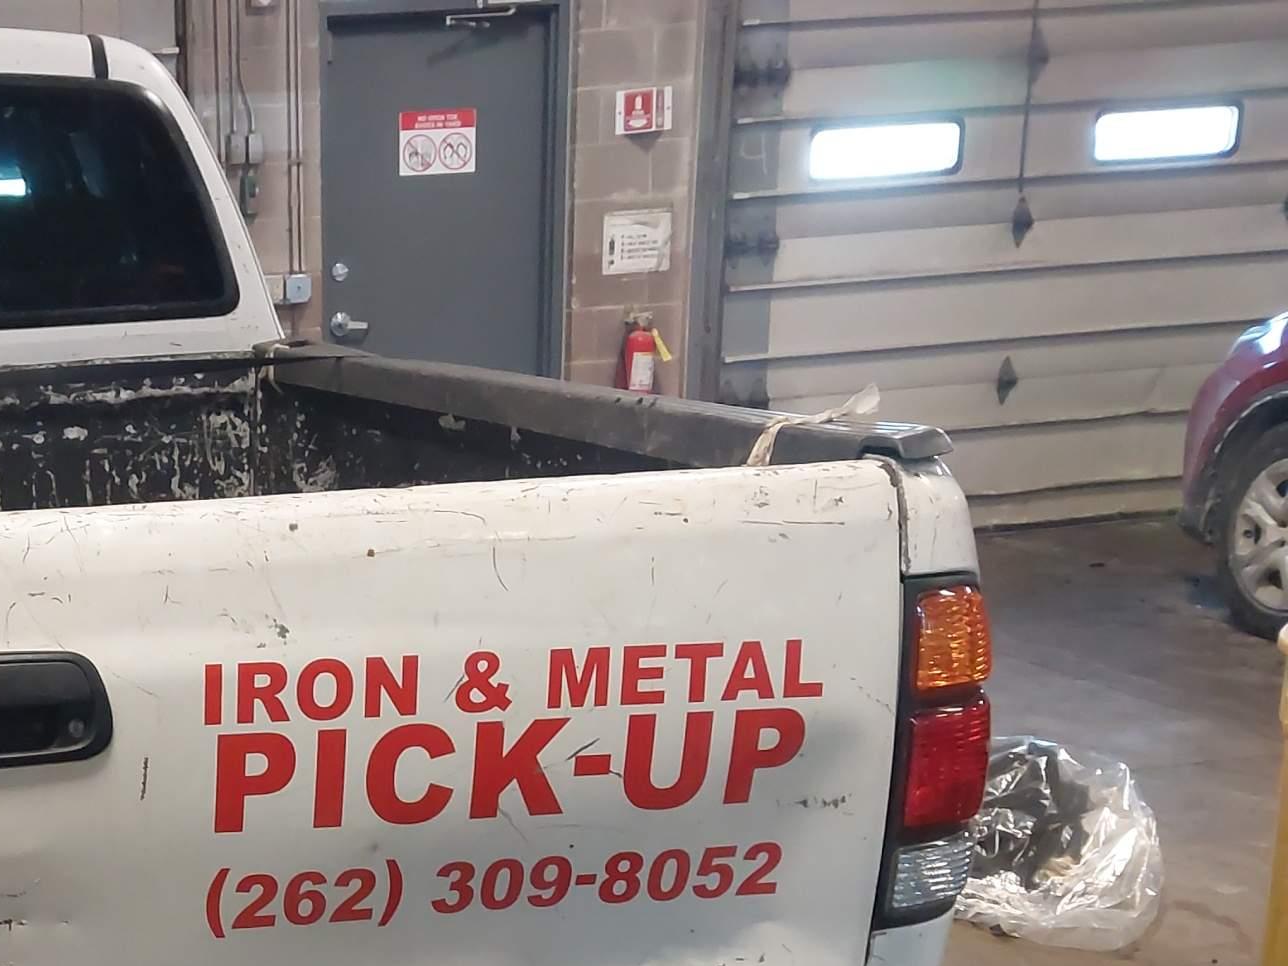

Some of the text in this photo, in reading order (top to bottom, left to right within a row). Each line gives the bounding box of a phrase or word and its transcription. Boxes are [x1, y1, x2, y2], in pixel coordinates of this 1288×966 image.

[203, 640, 824, 727] IRON & METAL
[214, 707, 805, 833] PICK-UP
[205, 843, 781, 938] (262) 309-8052
